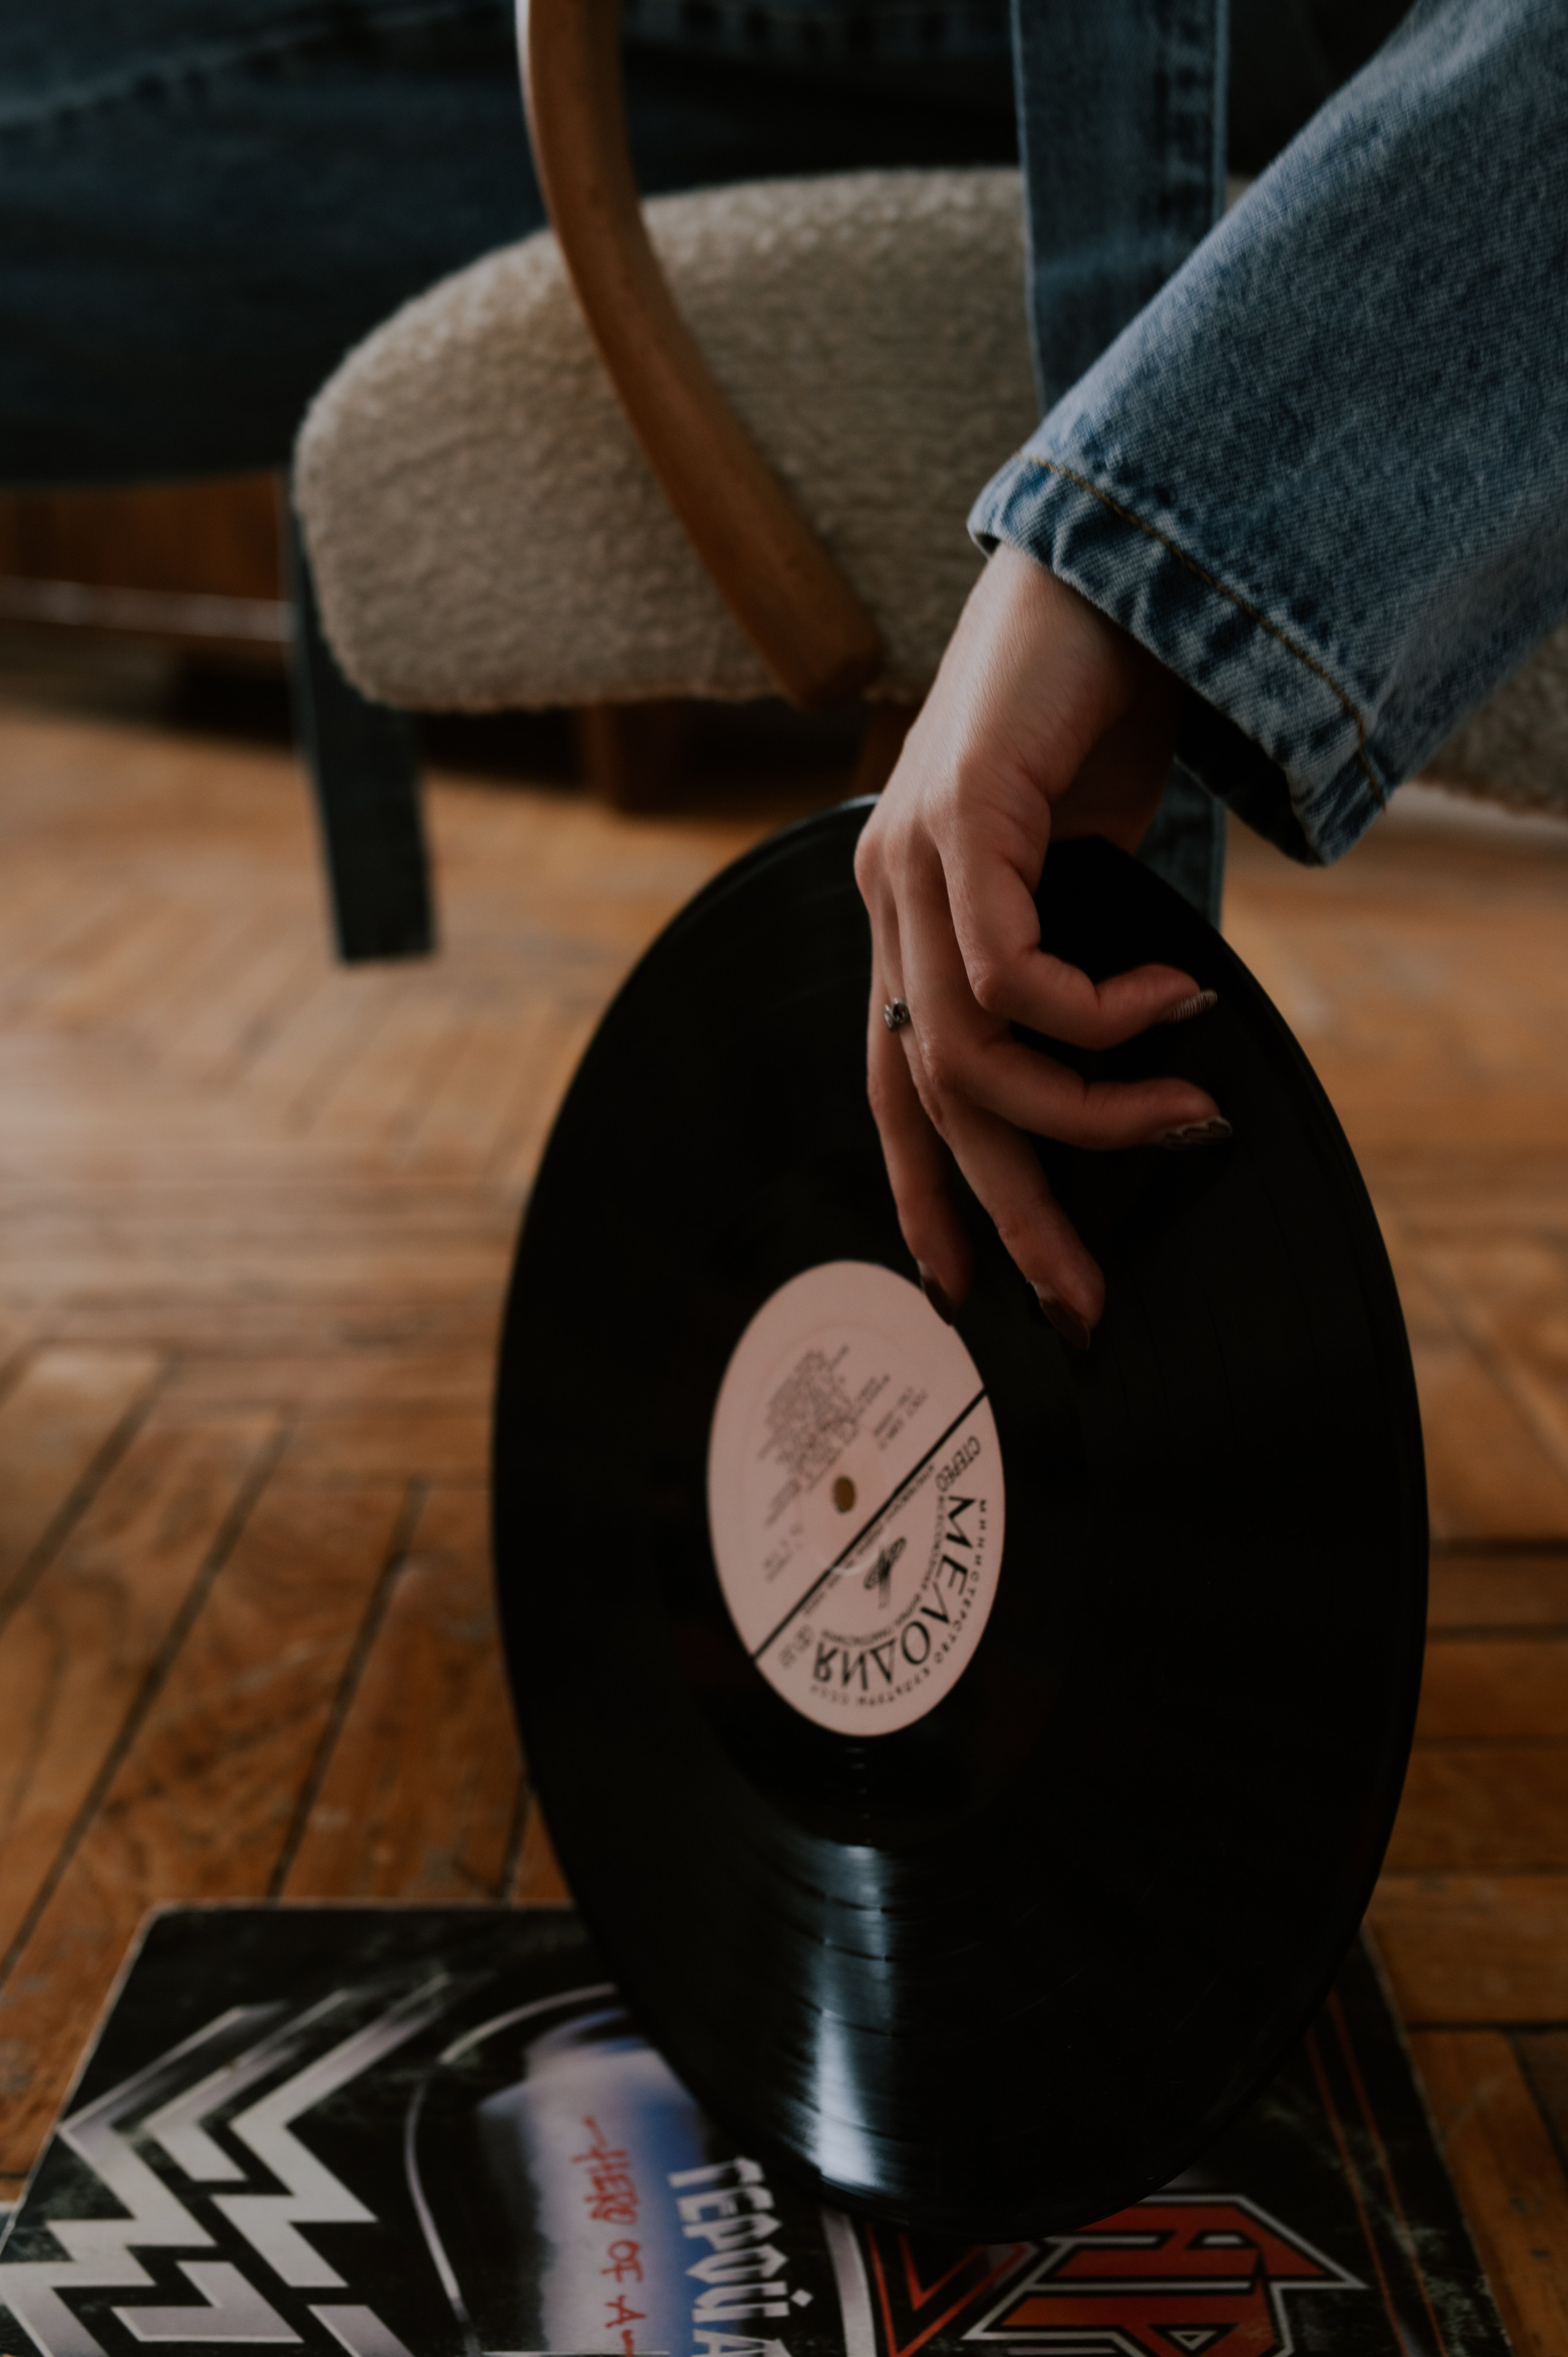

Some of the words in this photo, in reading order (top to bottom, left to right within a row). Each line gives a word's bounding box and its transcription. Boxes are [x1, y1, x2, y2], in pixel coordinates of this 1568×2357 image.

[935, 1435, 981, 1493] СТЕРЕО
[813, 1495, 976, 1691] МЕЛОДИЯ
[571, 2116, 639, 2225] HERO
[601, 2241, 643, 2283] OF
[668, 2155, 815, 2323] ГЕРОЙ
